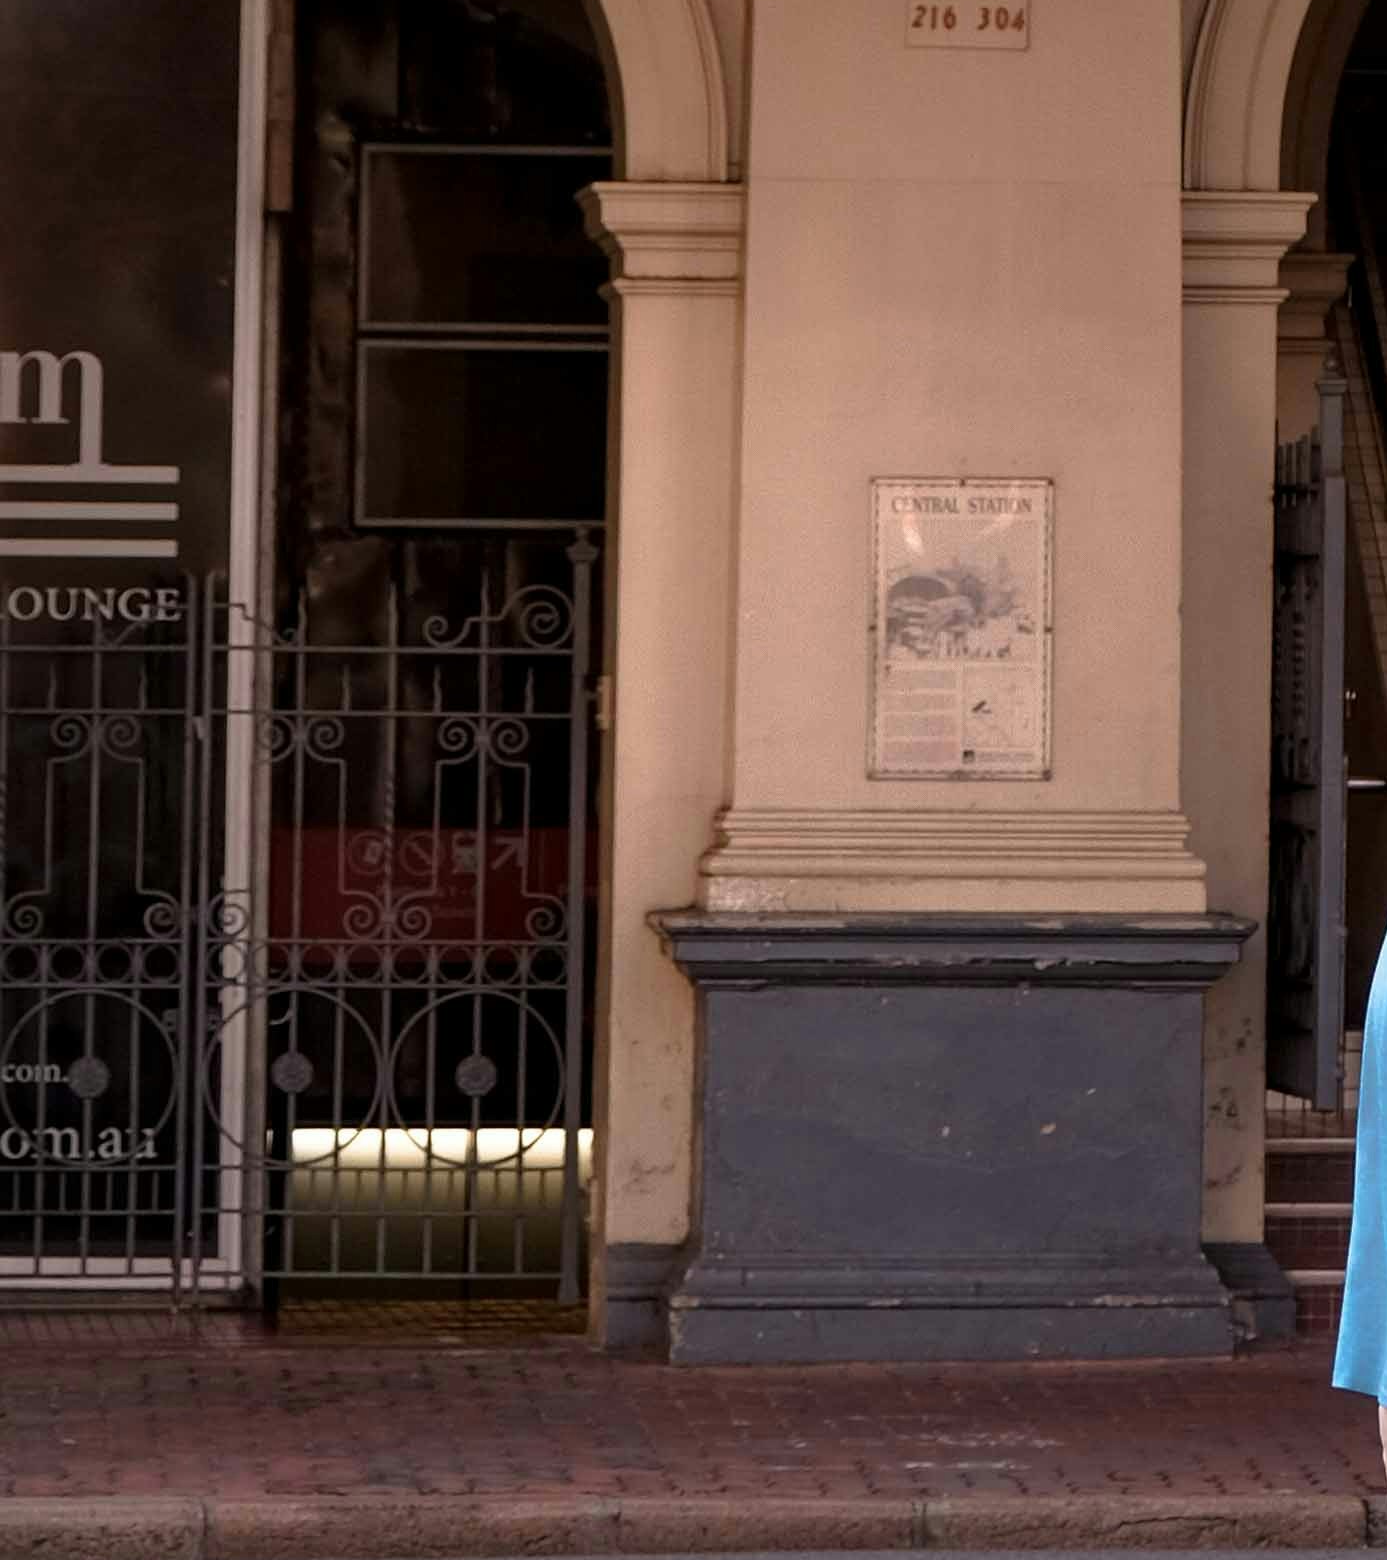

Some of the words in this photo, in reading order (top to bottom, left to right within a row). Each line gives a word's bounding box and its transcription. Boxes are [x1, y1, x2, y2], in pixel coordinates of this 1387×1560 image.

[912, 4, 957, 30] 216
[977, 7, 1025, 32] 304
[891, 496, 960, 514] CENTRAL
[968, 497, 1034, 515] STATION
[0, 585, 183, 622] OUNGE
